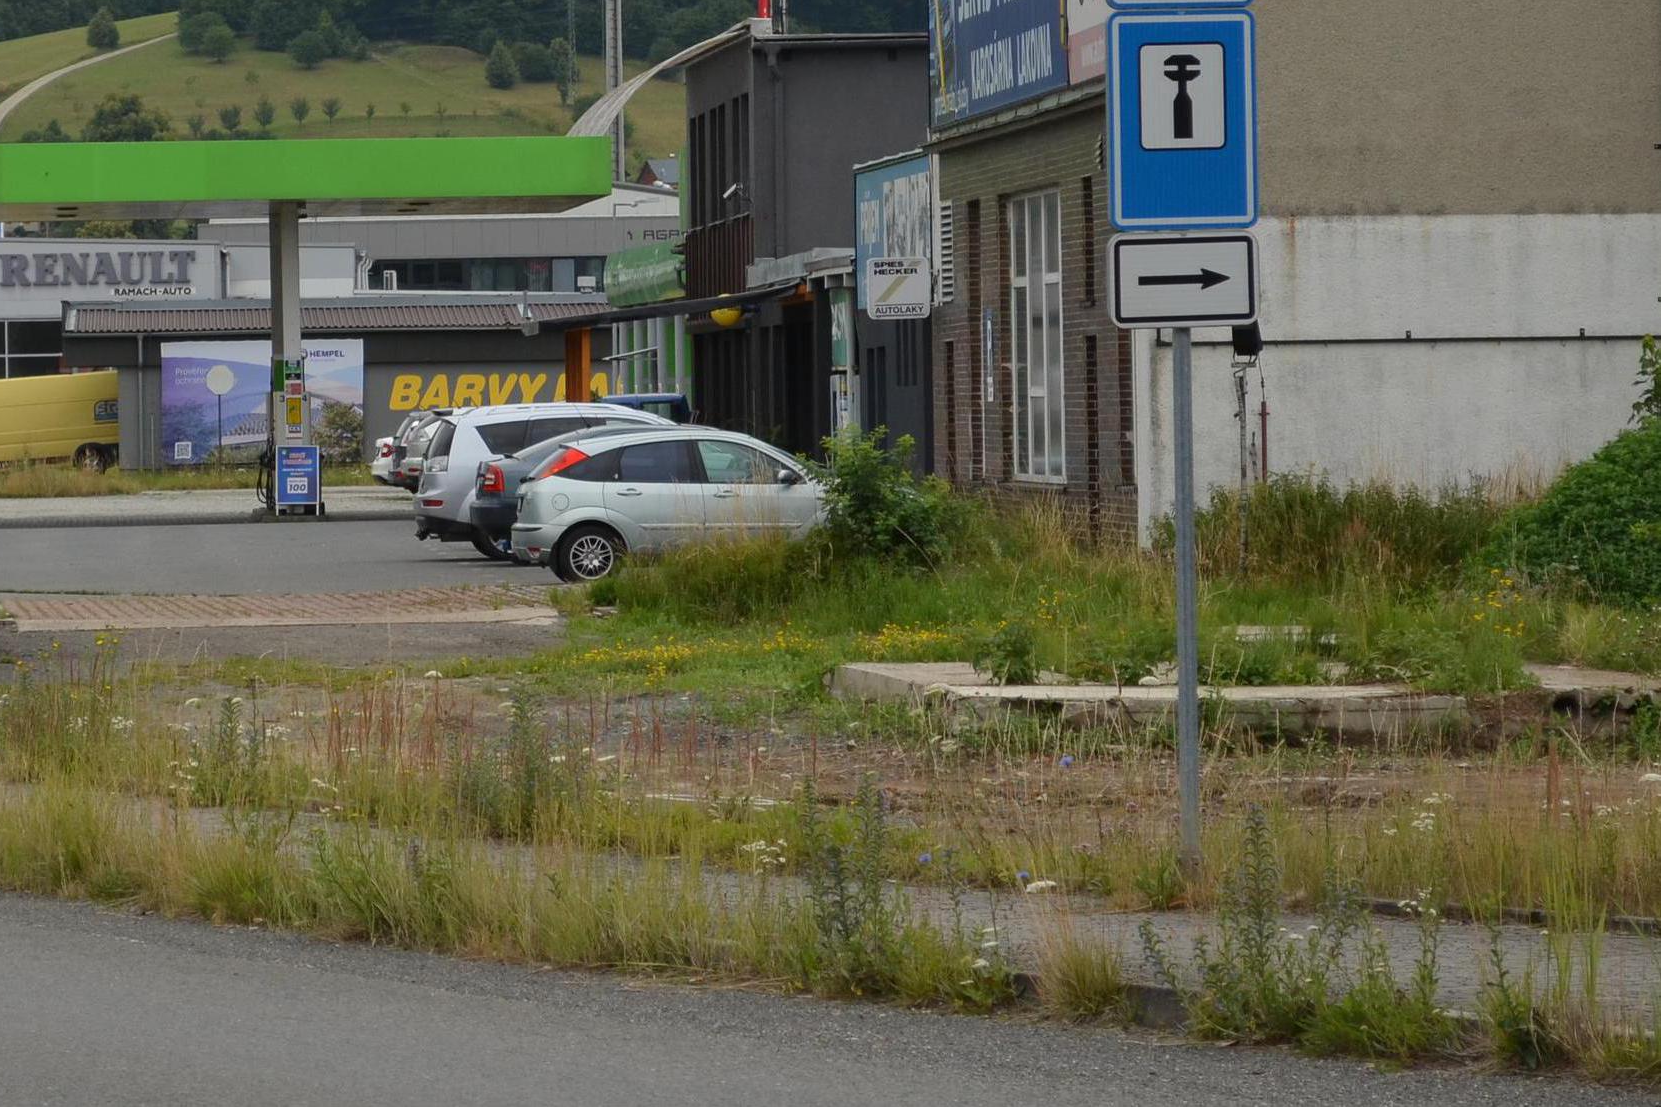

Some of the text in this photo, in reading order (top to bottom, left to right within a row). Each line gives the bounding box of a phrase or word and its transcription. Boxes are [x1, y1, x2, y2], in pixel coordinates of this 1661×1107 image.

[970, 30, 1014, 100] KAROSÁRNA
[1016, 22, 1053, 86] LAKOVNA
[873, 260, 905, 268] SPIES
[873, 267, 918, 275] HECKER
[114, 287, 193, 296] RAMACH-AUTO
[875, 305, 924, 314] AUTOLAKY
[309, 350, 345, 358] HEMPEL
[389, 373, 547, 411] BARVY
[288, 484, 307, 492] 100
